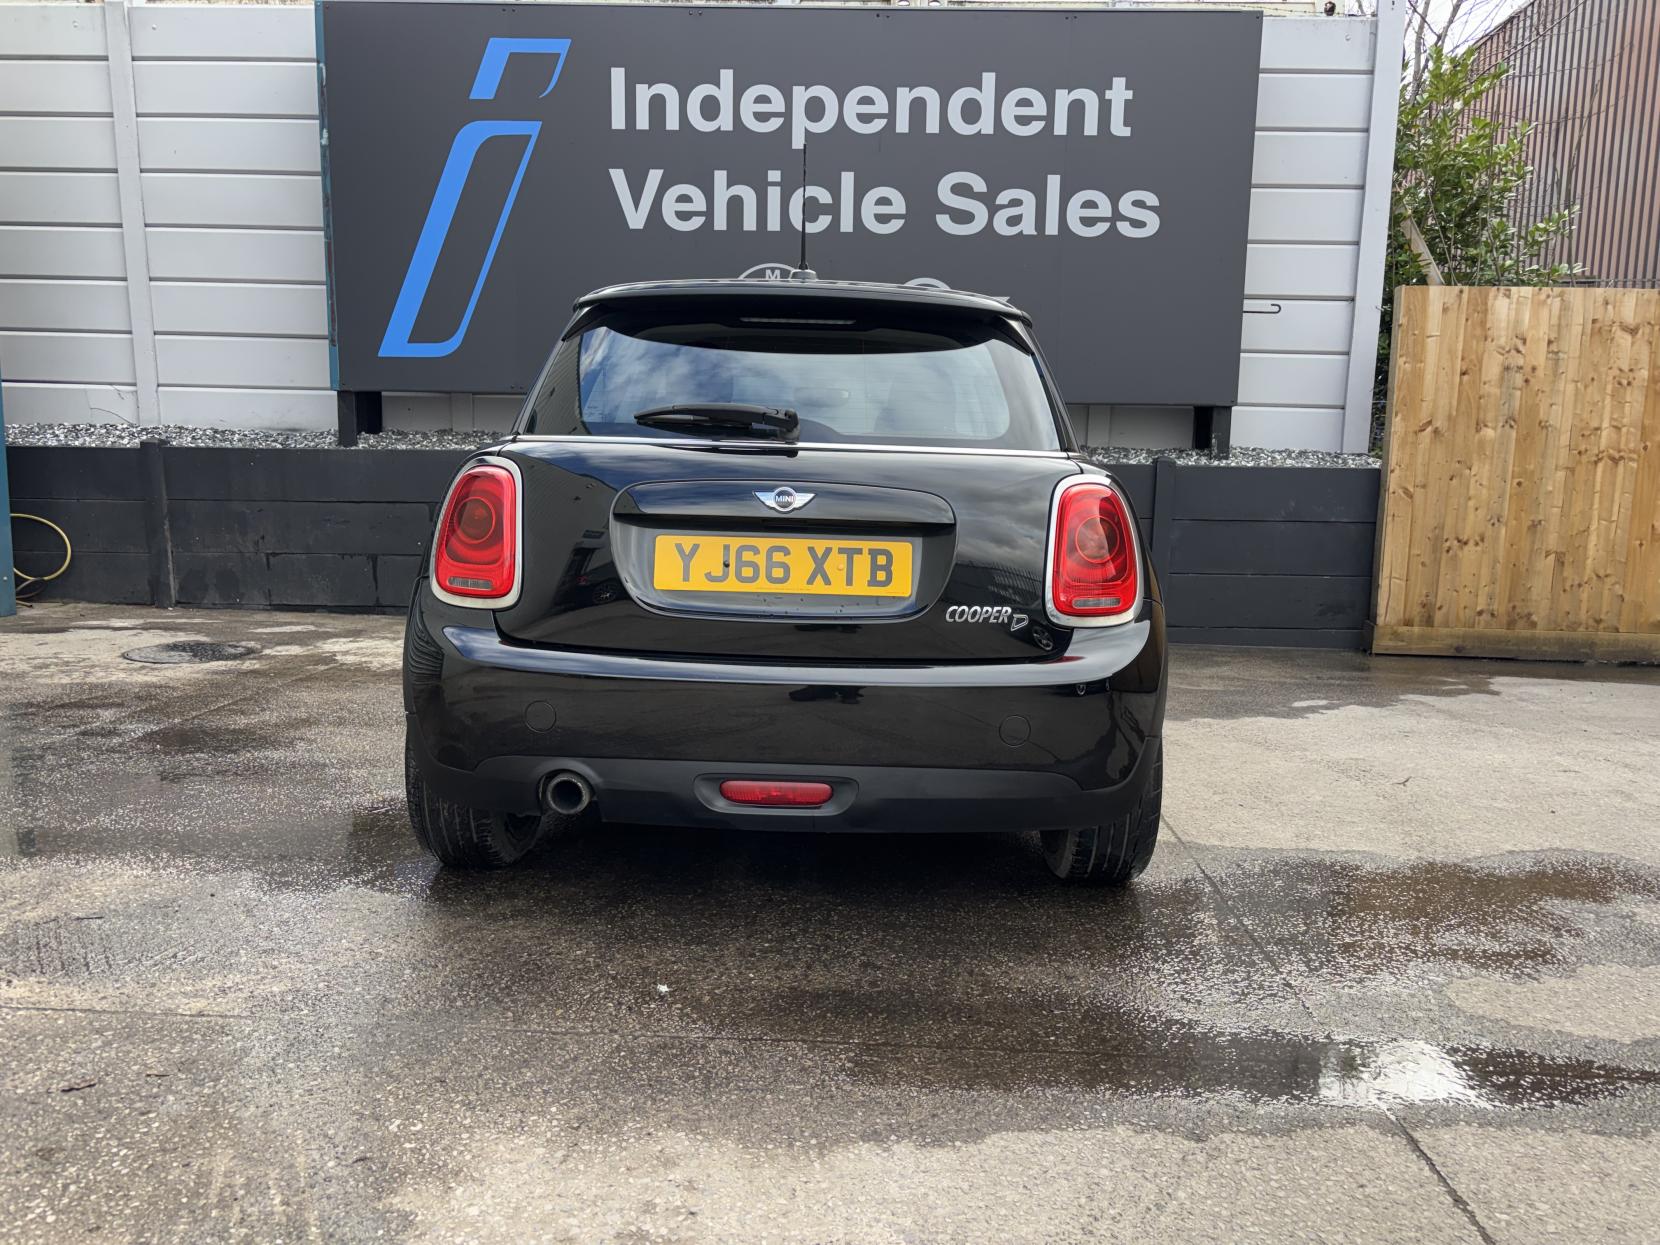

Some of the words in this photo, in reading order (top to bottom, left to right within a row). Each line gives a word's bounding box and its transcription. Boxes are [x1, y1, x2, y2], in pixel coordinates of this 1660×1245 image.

[610, 67, 1134, 150] Independent
[609, 168, 907, 234] Vehicle
[936, 171, 1161, 238] Sales
[775, 495, 794, 503] MINI
[674, 543, 791, 585] YJ66
[806, 546, 894, 588] XTB
[945, 605, 1012, 623] COOPER
[1010, 613, 1029, 632] D
